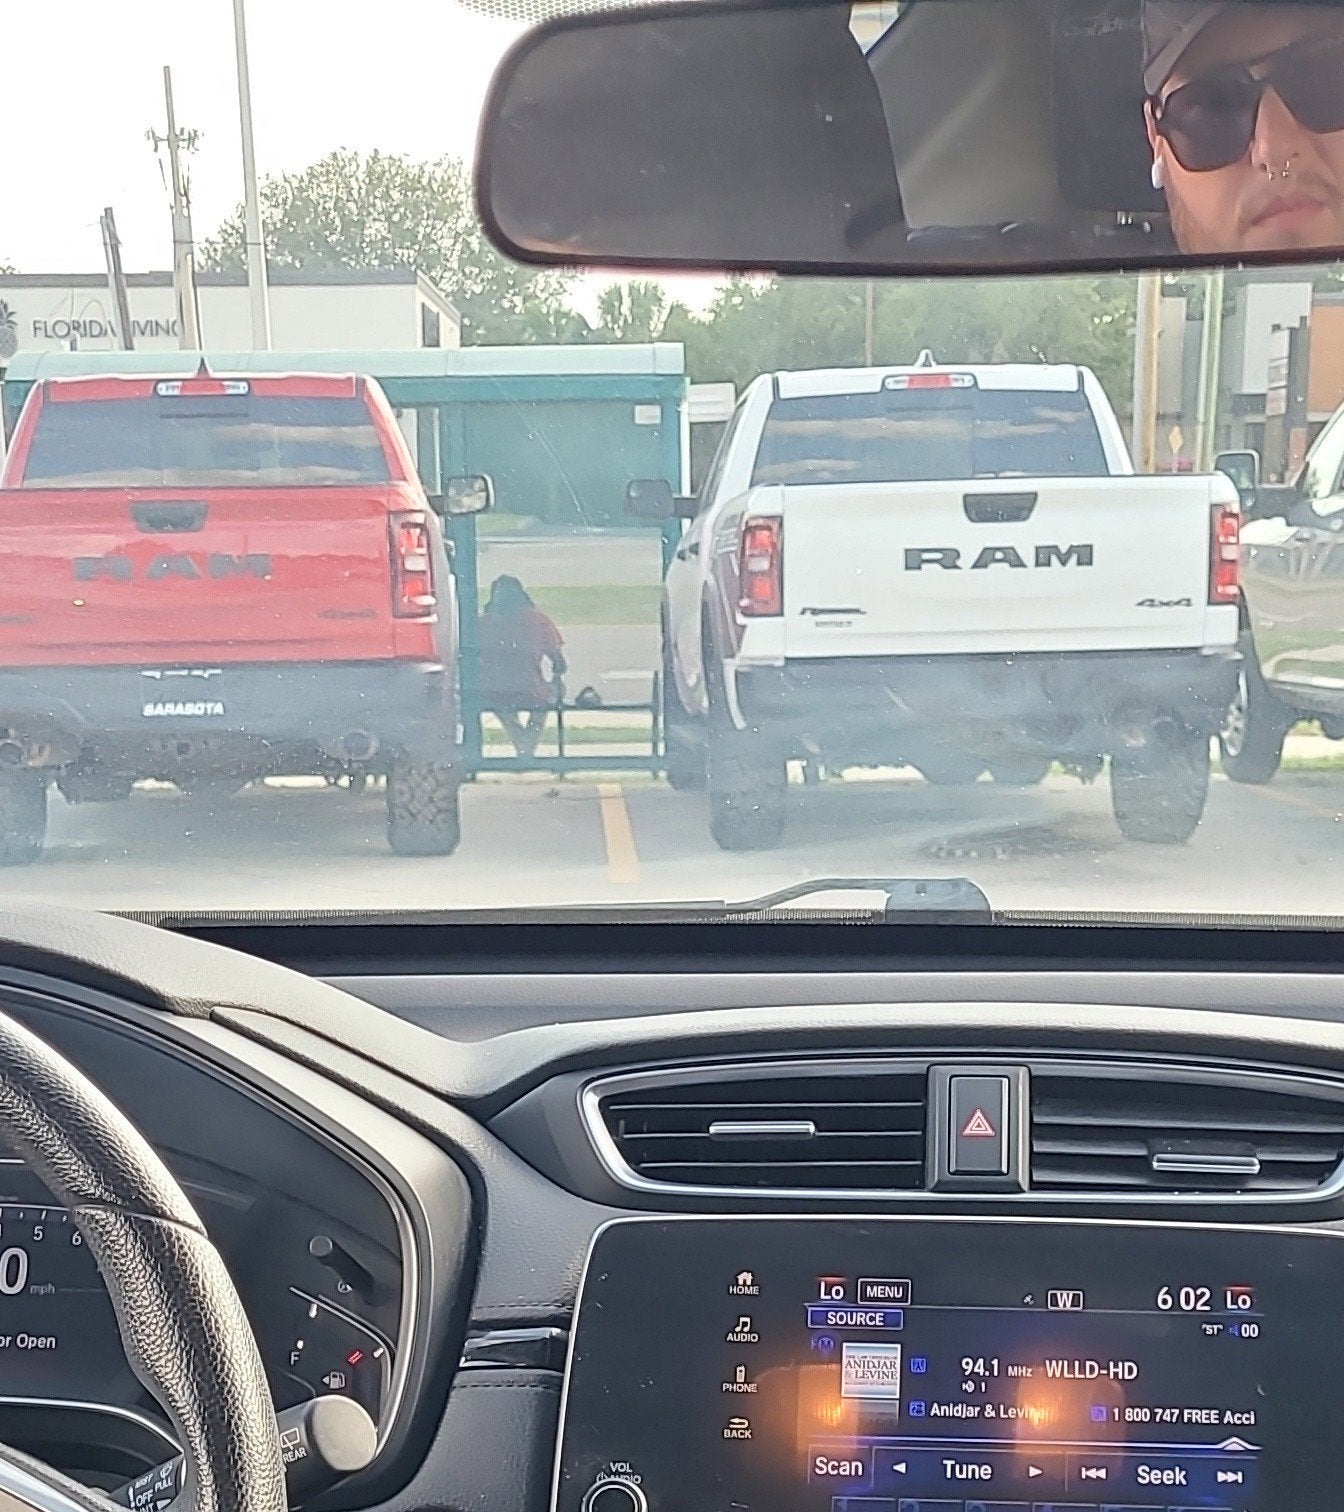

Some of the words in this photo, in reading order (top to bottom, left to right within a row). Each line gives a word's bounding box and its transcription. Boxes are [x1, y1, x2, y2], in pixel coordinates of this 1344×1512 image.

[904, 544, 1094, 571] RAM
[74, 553, 271, 582] RAM
[1135, 598, 1194, 608] 4x4
[142, 701, 226, 717] SARASOTA
[33, 1226, 44, 1241] 5
[72, 1231, 82, 1247] 6
[29, 1282, 56, 1296] mph
[729, 1285, 759, 1295] HOME
[819, 1281, 845, 1301] Lo
[865, 1284, 904, 1299] MENU
[1056, 1292, 1074, 1308] W
[1225, 1290, 1252, 1310] Lo
[826, 1311, 885, 1326] SOURCE
[726, 1332, 759, 1343] AUDIO
[1241, 1323, 1259, 1338] 00
[16, 1332, 57, 1350] Open
[290, 1350, 301, 1366] F
[844, 1359, 897, 1370] ANIDJAR
[854, 1370, 898, 1380] LEVINE
[961, 1357, 1000, 1377] 94.1
[1007, 1365, 1033, 1378] MHz
[1045, 1359, 1138, 1381] WLLD-HD
[722, 1382, 758, 1393] PHONE
[929, 1402, 982, 1420] Anidjar
[984, 1404, 996, 1418] &
[1113, 1407, 1120, 1422] 1
[1124, 1407, 1151, 1423] 800
[1155, 1408, 1180, 1424] 747
[1184, 1409, 1220, 1425] FREE
[723, 1428, 752, 1439] BACK
[282, 1448, 307, 1464] REAR
[610, 1462, 633, 1473] VOL
[814, 1456, 864, 1478] Scan
[943, 1459, 993, 1481] Tune
[1136, 1464, 1188, 1486] Seek
[154, 1476, 174, 1492] PULL
[135, 1489, 154, 1507] OFF
